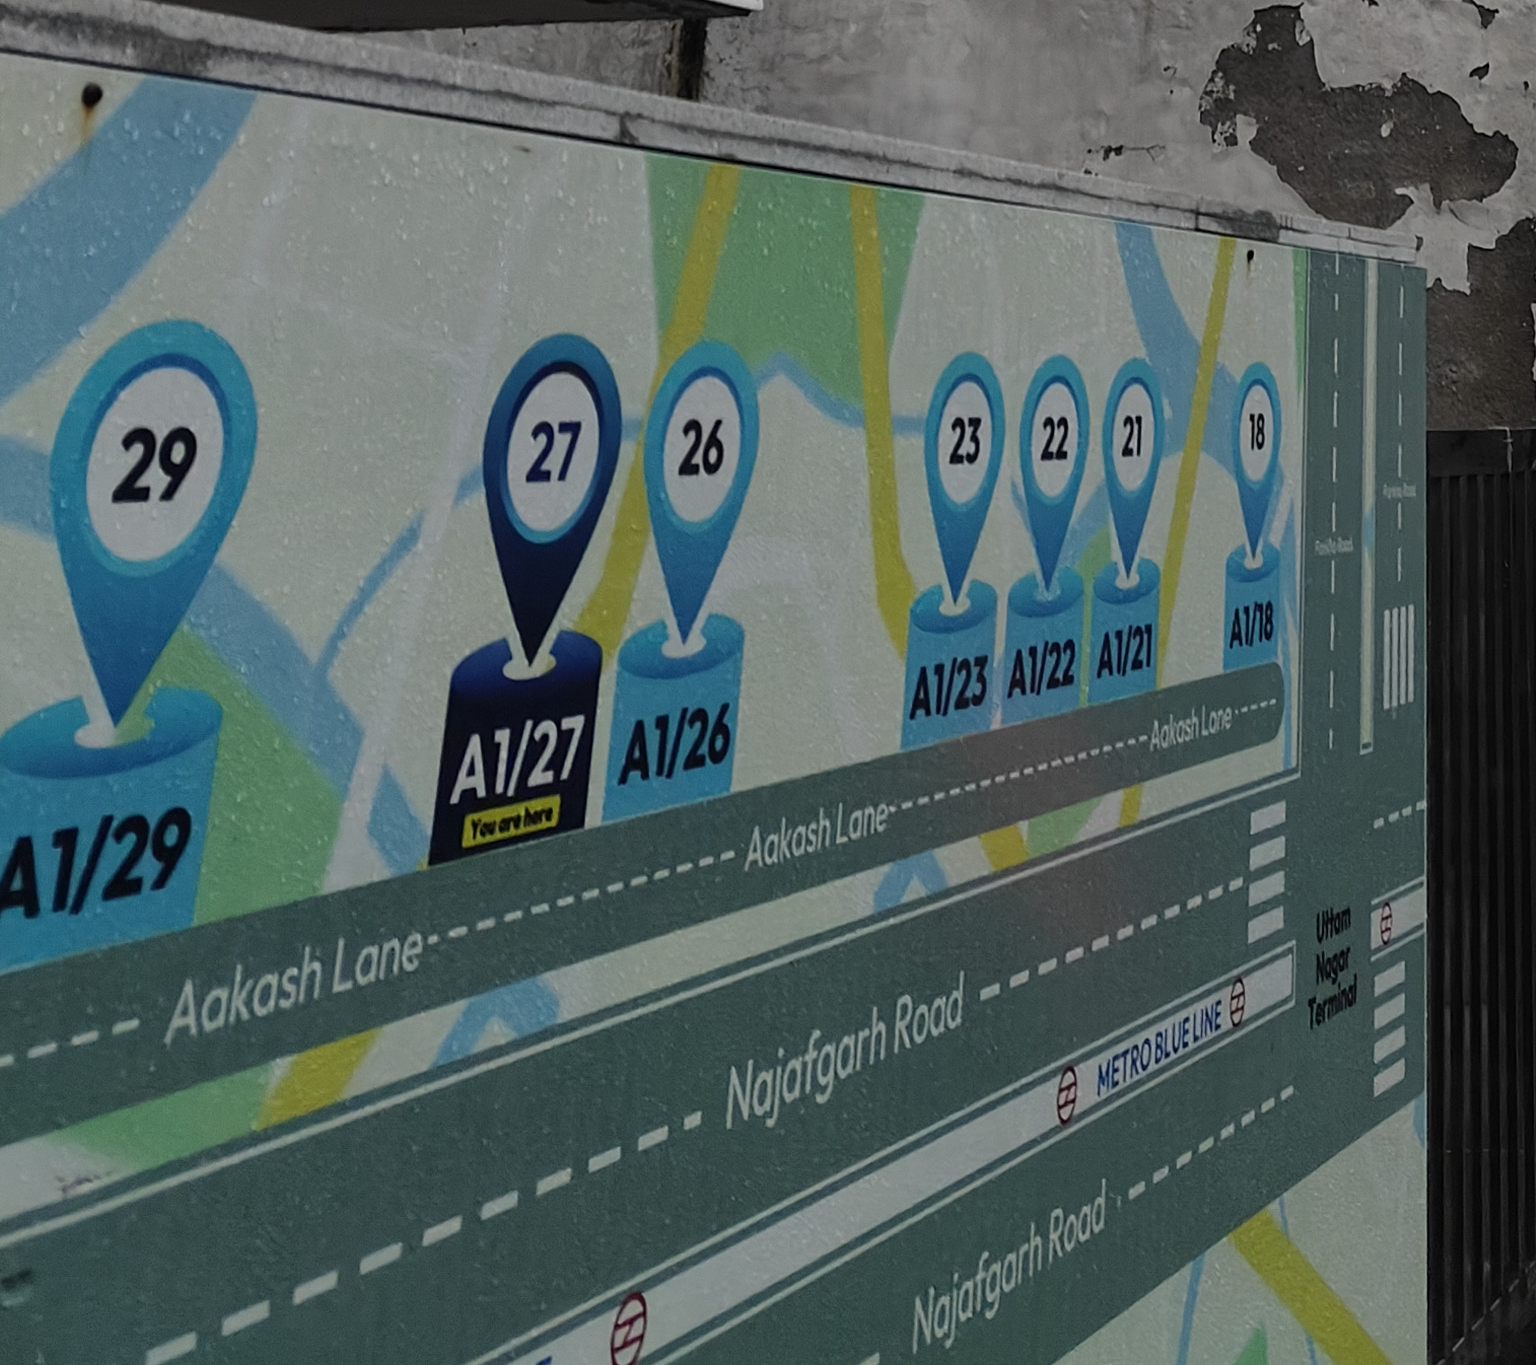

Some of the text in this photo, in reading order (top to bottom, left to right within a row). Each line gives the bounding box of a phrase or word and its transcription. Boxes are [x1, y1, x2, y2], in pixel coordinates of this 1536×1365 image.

[524, 420, 583, 483] 27
[677, 418, 725, 477] 26
[948, 416, 982, 466] 23
[1041, 416, 1070, 461] 22
[1121, 414, 1143, 458] 21
[1248, 412, 1266, 451] 18
[111, 426, 198, 504] 29
[1096, 624, 1153, 679] A1/21
[1229, 600, 1274, 650] A1/18
[908, 655, 989, 721] A1/23
[1006, 639, 1077, 699] A1/22
[616, 702, 731, 786] A1/26
[1150, 703, 1233, 750] Aakash Lane
[448, 714, 586, 805] A1/27
[471, 805, 554, 841] You are here
[744, 803, 889, 871] Aakash Lane
[0, 806, 193, 919] A1/29
[1316, 907, 1351, 944] Uttam
[164, 933, 425, 1046] Aakash Lane
[1316, 947, 1350, 986] Nagar
[1308, 972, 1357, 1030] Terminal
[725, 971, 966, 1129] Najafgarh Road
[1096, 1000, 1223, 1097] METRO BLUE LINE
[911, 1178, 1108, 1355] Najafgarh Road
